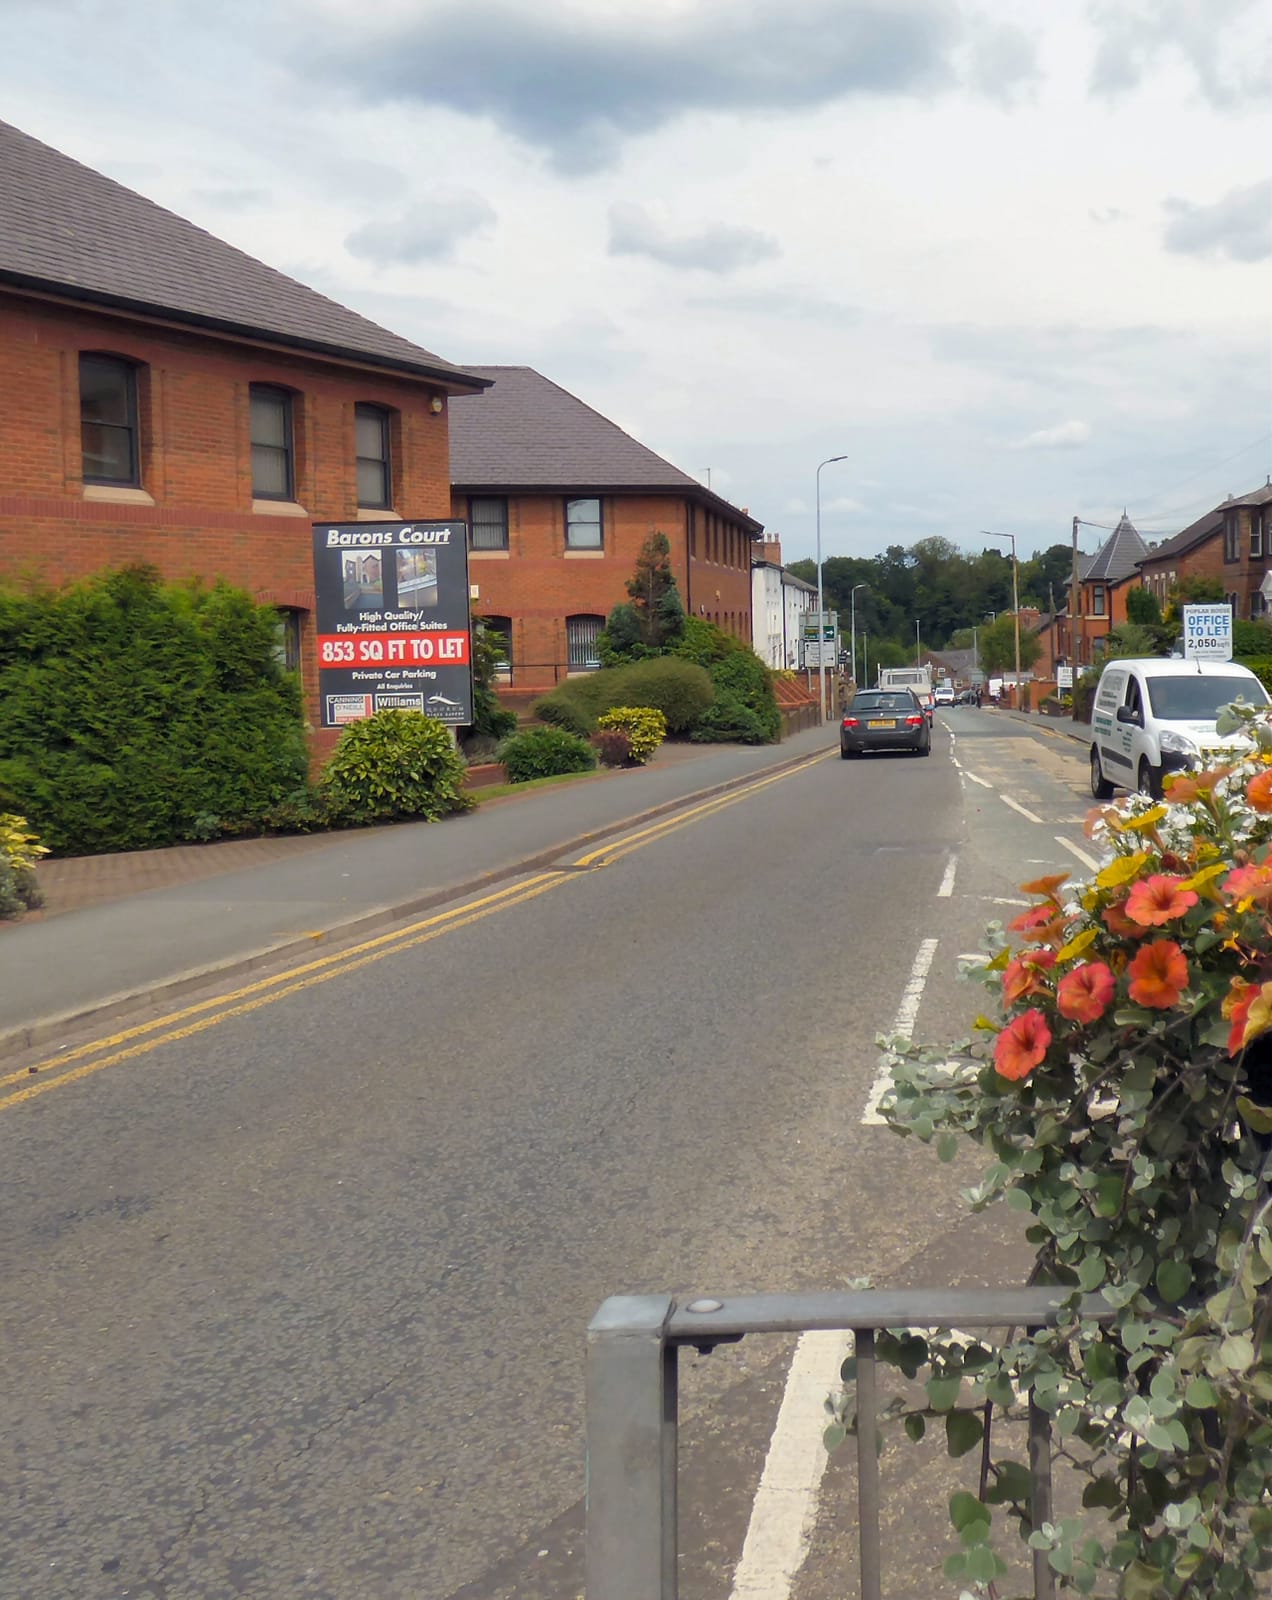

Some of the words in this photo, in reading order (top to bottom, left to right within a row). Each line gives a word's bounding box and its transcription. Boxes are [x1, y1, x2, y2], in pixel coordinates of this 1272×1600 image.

[326, 529, 392, 546] Barons
[399, 527, 451, 544] Court
[359, 611, 382, 623] High
[1188, 615, 1230, 625] OFFICE
[336, 622, 387, 634] Fully-Fitted
[389, 621, 418, 631] Office
[420, 621, 447, 630] Suites
[1188, 626, 1204, 636] TO
[1207, 625, 1229, 636] LET
[1188, 638, 1217, 649] 2,050
[322, 640, 355, 662] 853
[359, 640, 384, 661] SQ
[388, 639, 406, 660] FT
[410, 638, 434, 659] TO
[438, 638, 464, 659] LET
[352, 671, 383, 680] Private
[384, 670, 400, 679] Car
[402, 669, 437, 680] Parking
[377, 696, 421, 707] Williams
